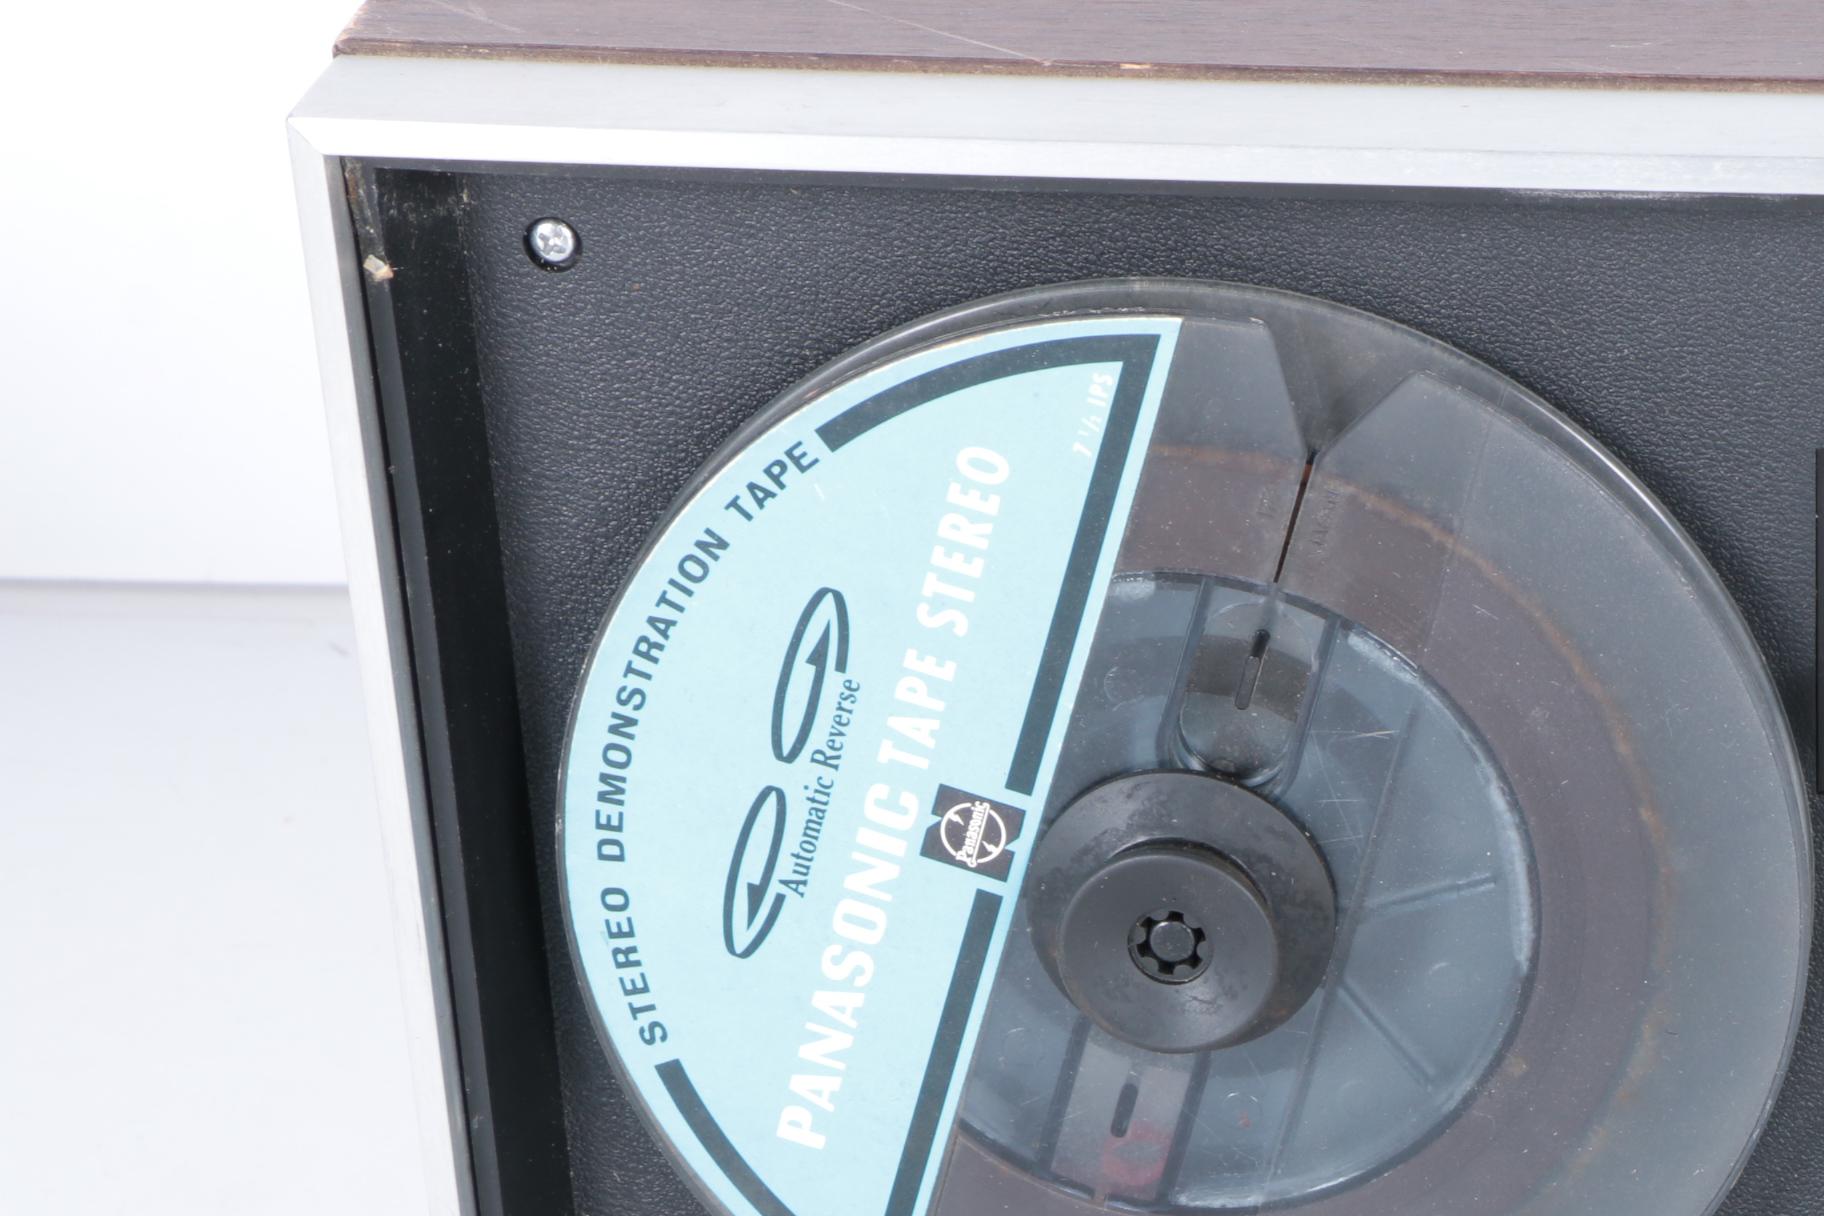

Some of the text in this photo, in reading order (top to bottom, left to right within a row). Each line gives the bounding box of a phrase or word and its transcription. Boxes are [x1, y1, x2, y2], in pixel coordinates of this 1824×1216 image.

[595, 440, 820, 1046] STEREO DEMONSTRATION TAPE
[775, 445, 1010, 1150] PANASONIC TAPE STEREO
[778, 678, 861, 899] Automatic Reverse
[955, 801, 991, 867] Panasonic
